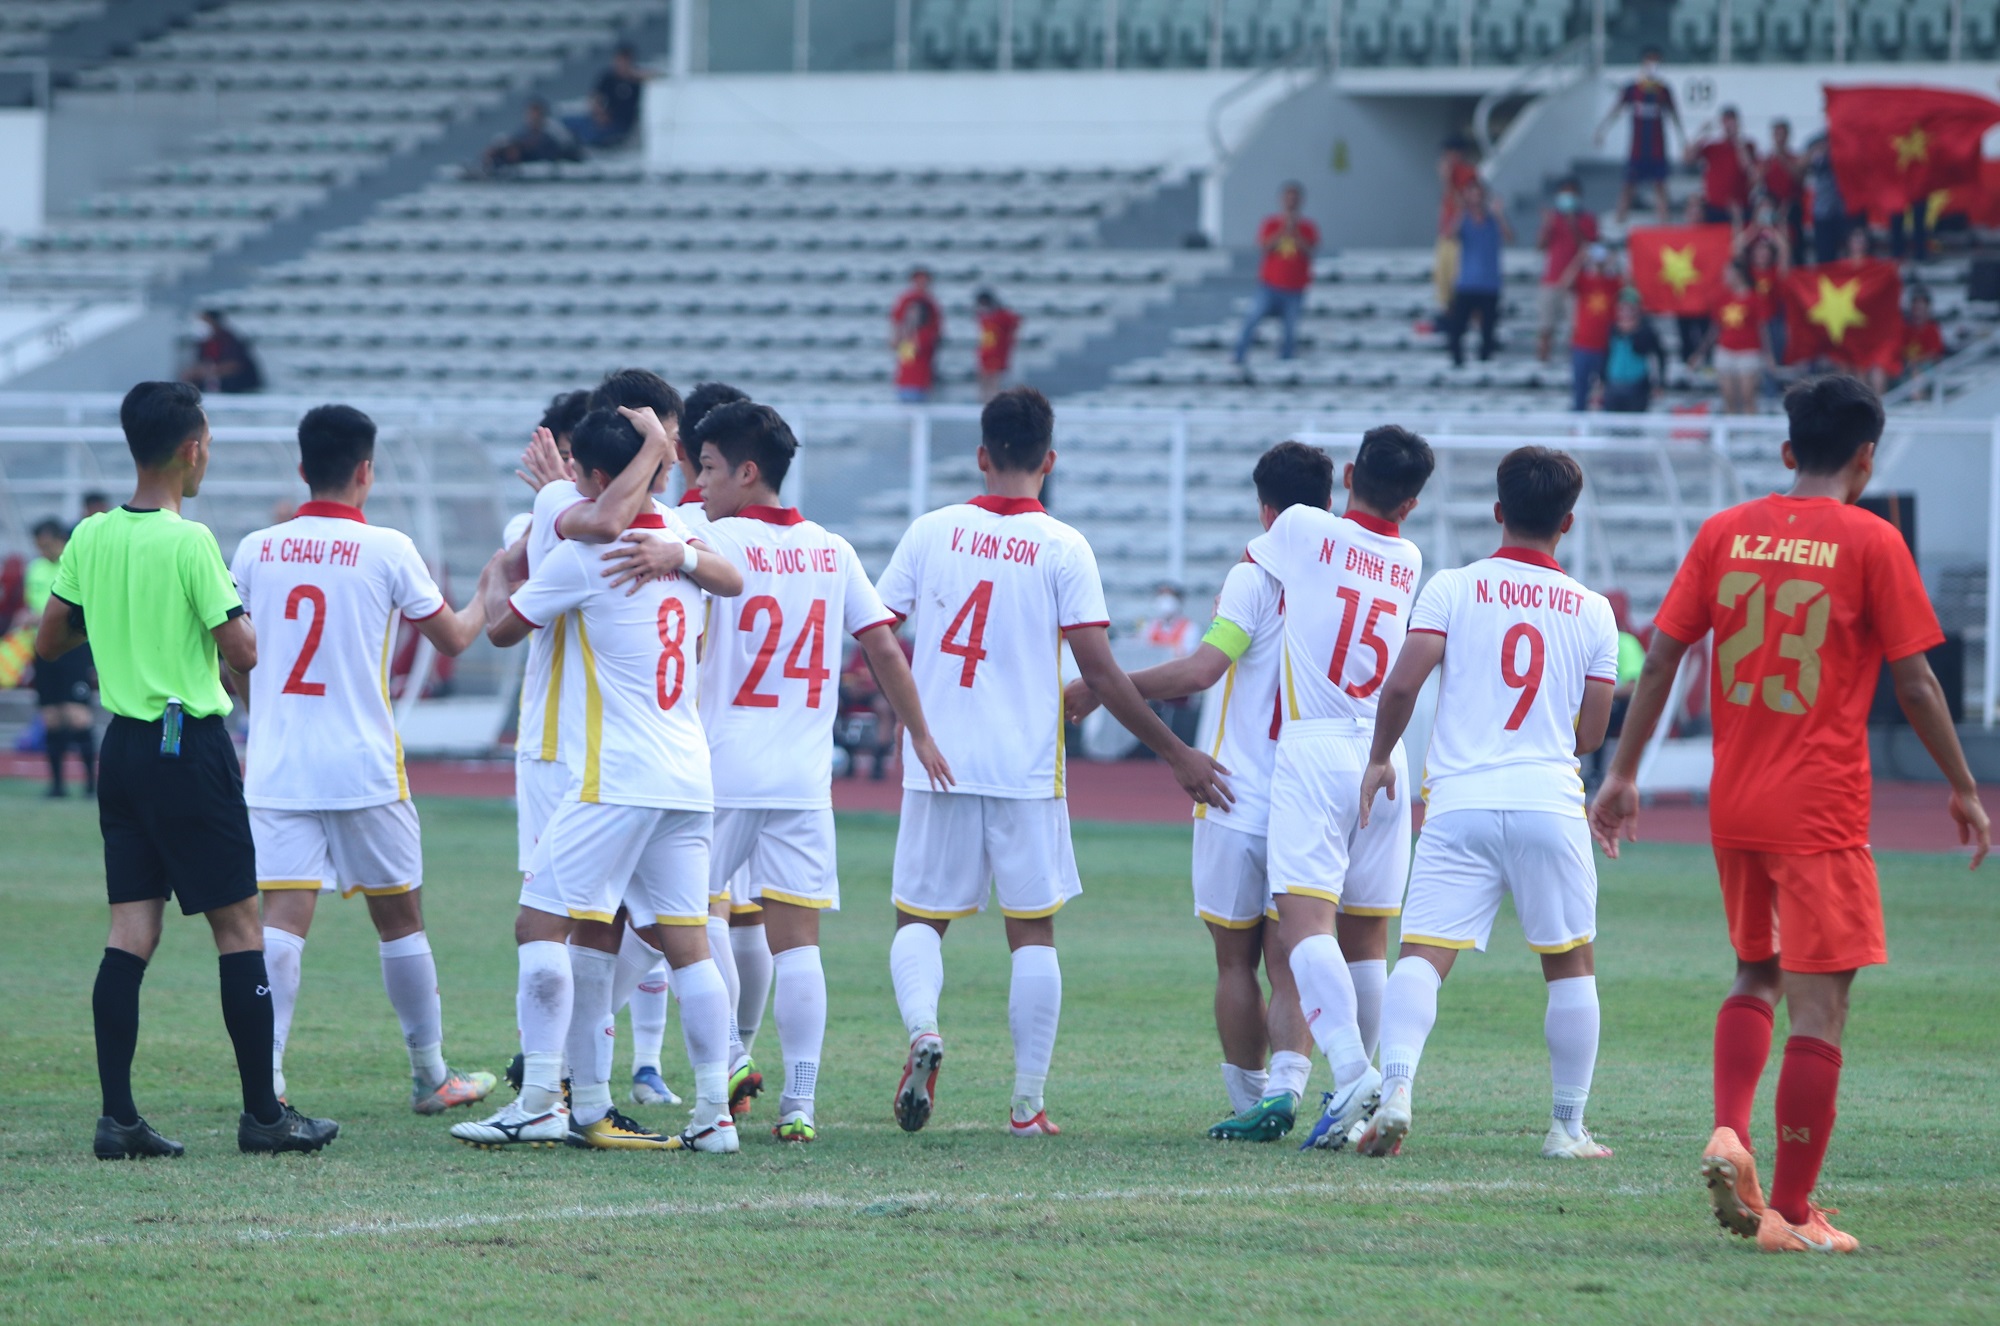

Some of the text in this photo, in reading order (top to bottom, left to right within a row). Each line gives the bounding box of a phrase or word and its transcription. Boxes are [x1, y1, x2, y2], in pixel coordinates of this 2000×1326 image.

[260, 538, 361, 567] H. CHAU PHI
[746, 546, 838, 575] NG. DUC VIET
[951, 526, 1041, 567] V. VAN SON
[1345, 546, 1385, 582] DINH
[1476, 579, 1585, 617] N. QUOC VIET
[1730, 534, 1839, 568] K.Z.HEIN
[282, 584, 326, 696] 2
[656, 596, 687, 711] 8
[732, 595, 831, 709] 24
[940, 579, 994, 689] 4
[1327, 585, 1398, 699] 15
[1500, 622, 1545, 731] 9
[1717, 570, 1831, 715] 23
